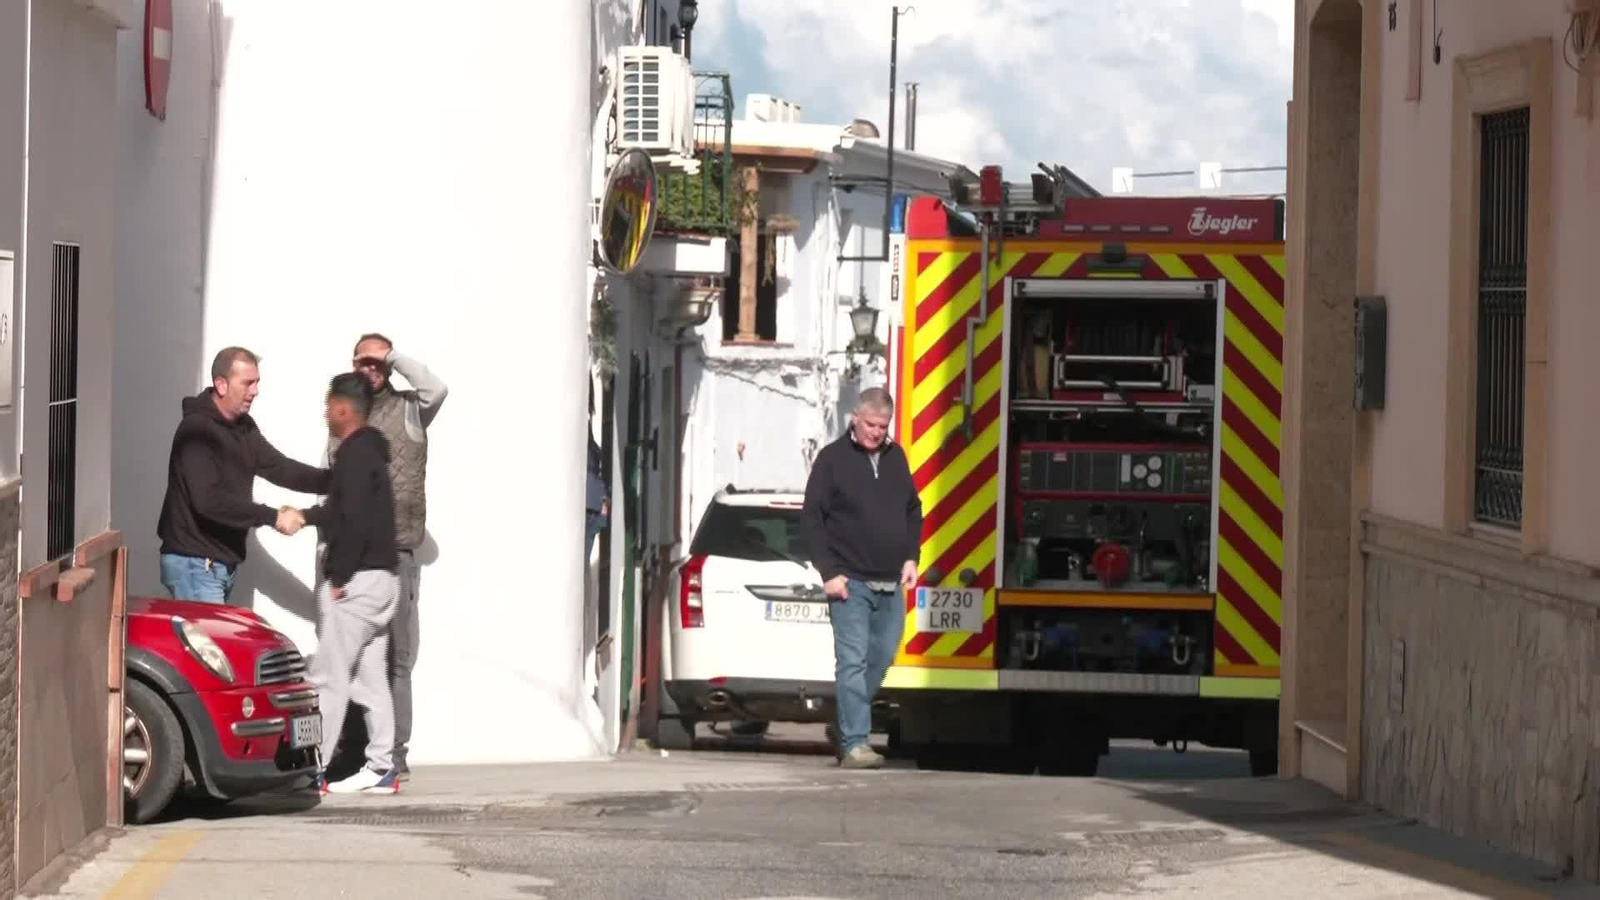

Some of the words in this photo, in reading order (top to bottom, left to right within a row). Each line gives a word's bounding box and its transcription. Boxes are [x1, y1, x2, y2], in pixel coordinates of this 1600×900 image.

[1188, 207, 1258, 236] Ziegler
[930, 591, 973, 608] 2730
[775, 604, 811, 618] 8870
[929, 611, 961, 628] LRR
